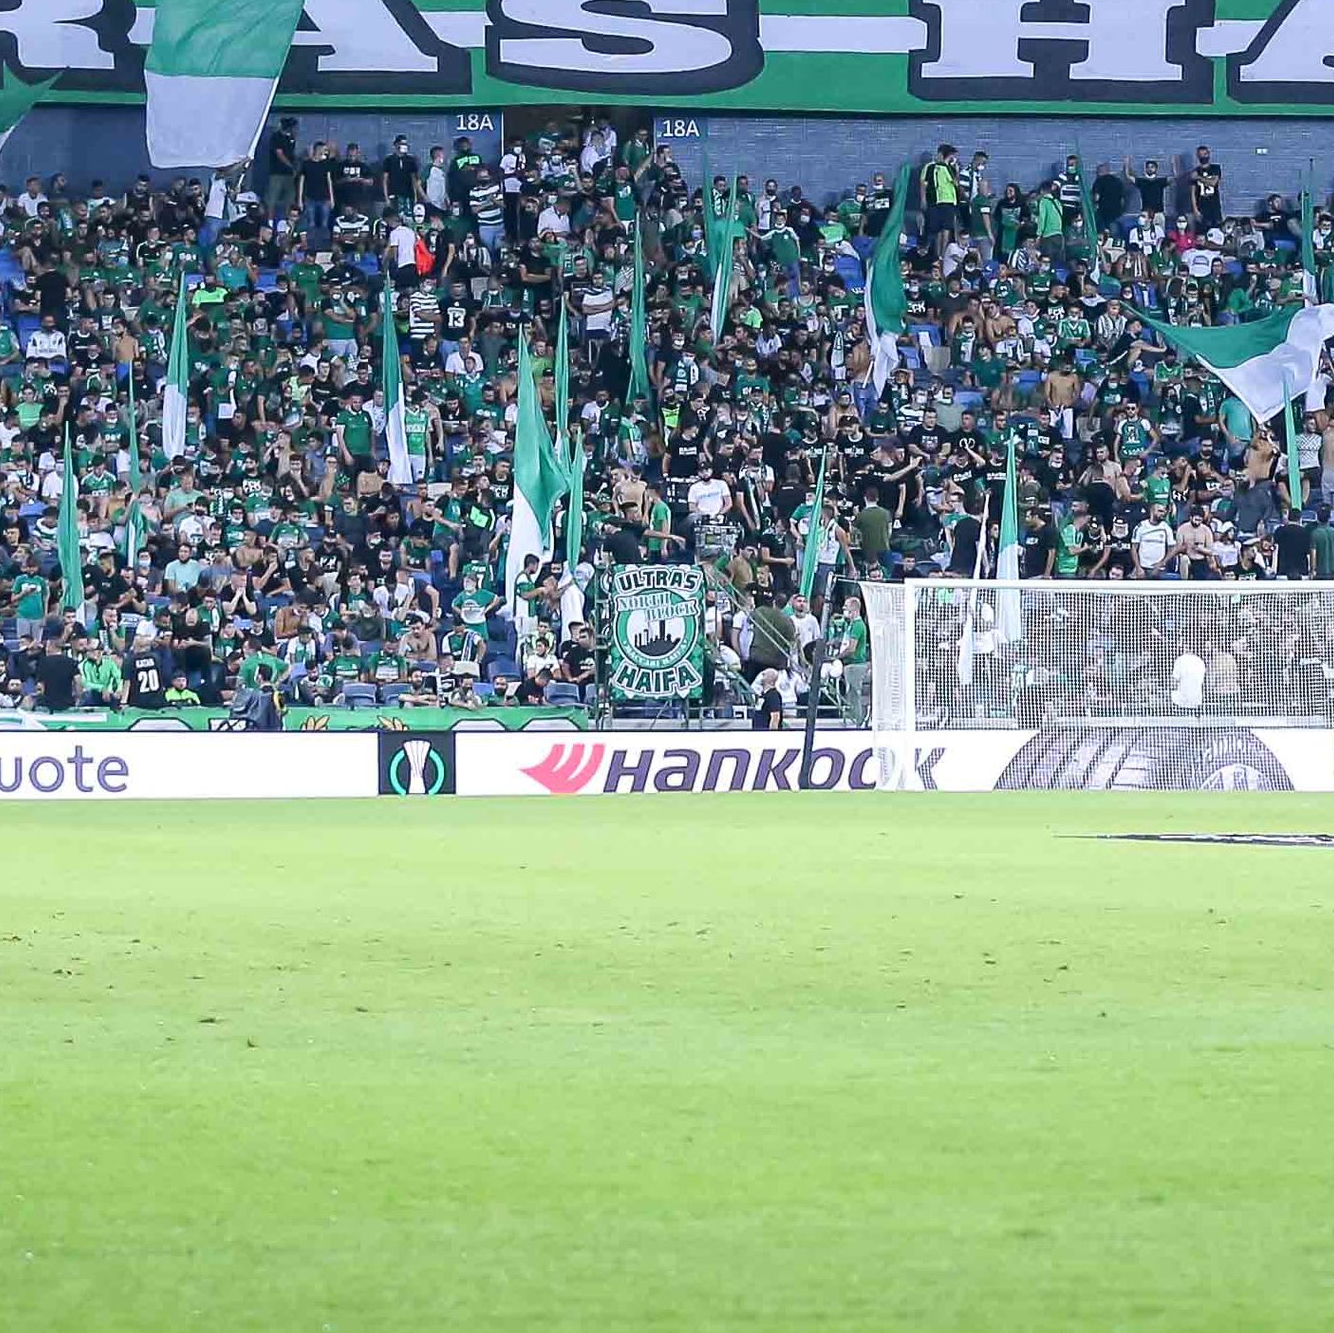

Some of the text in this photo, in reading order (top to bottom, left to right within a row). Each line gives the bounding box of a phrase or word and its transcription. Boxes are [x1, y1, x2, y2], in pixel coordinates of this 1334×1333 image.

[455, 114, 494, 132] 18A
[662, 119, 700, 138] 18A
[618, 570, 698, 591] ULTRAS
[138, 669, 161, 694] 20
[617, 664, 697, 693] HAIFA
